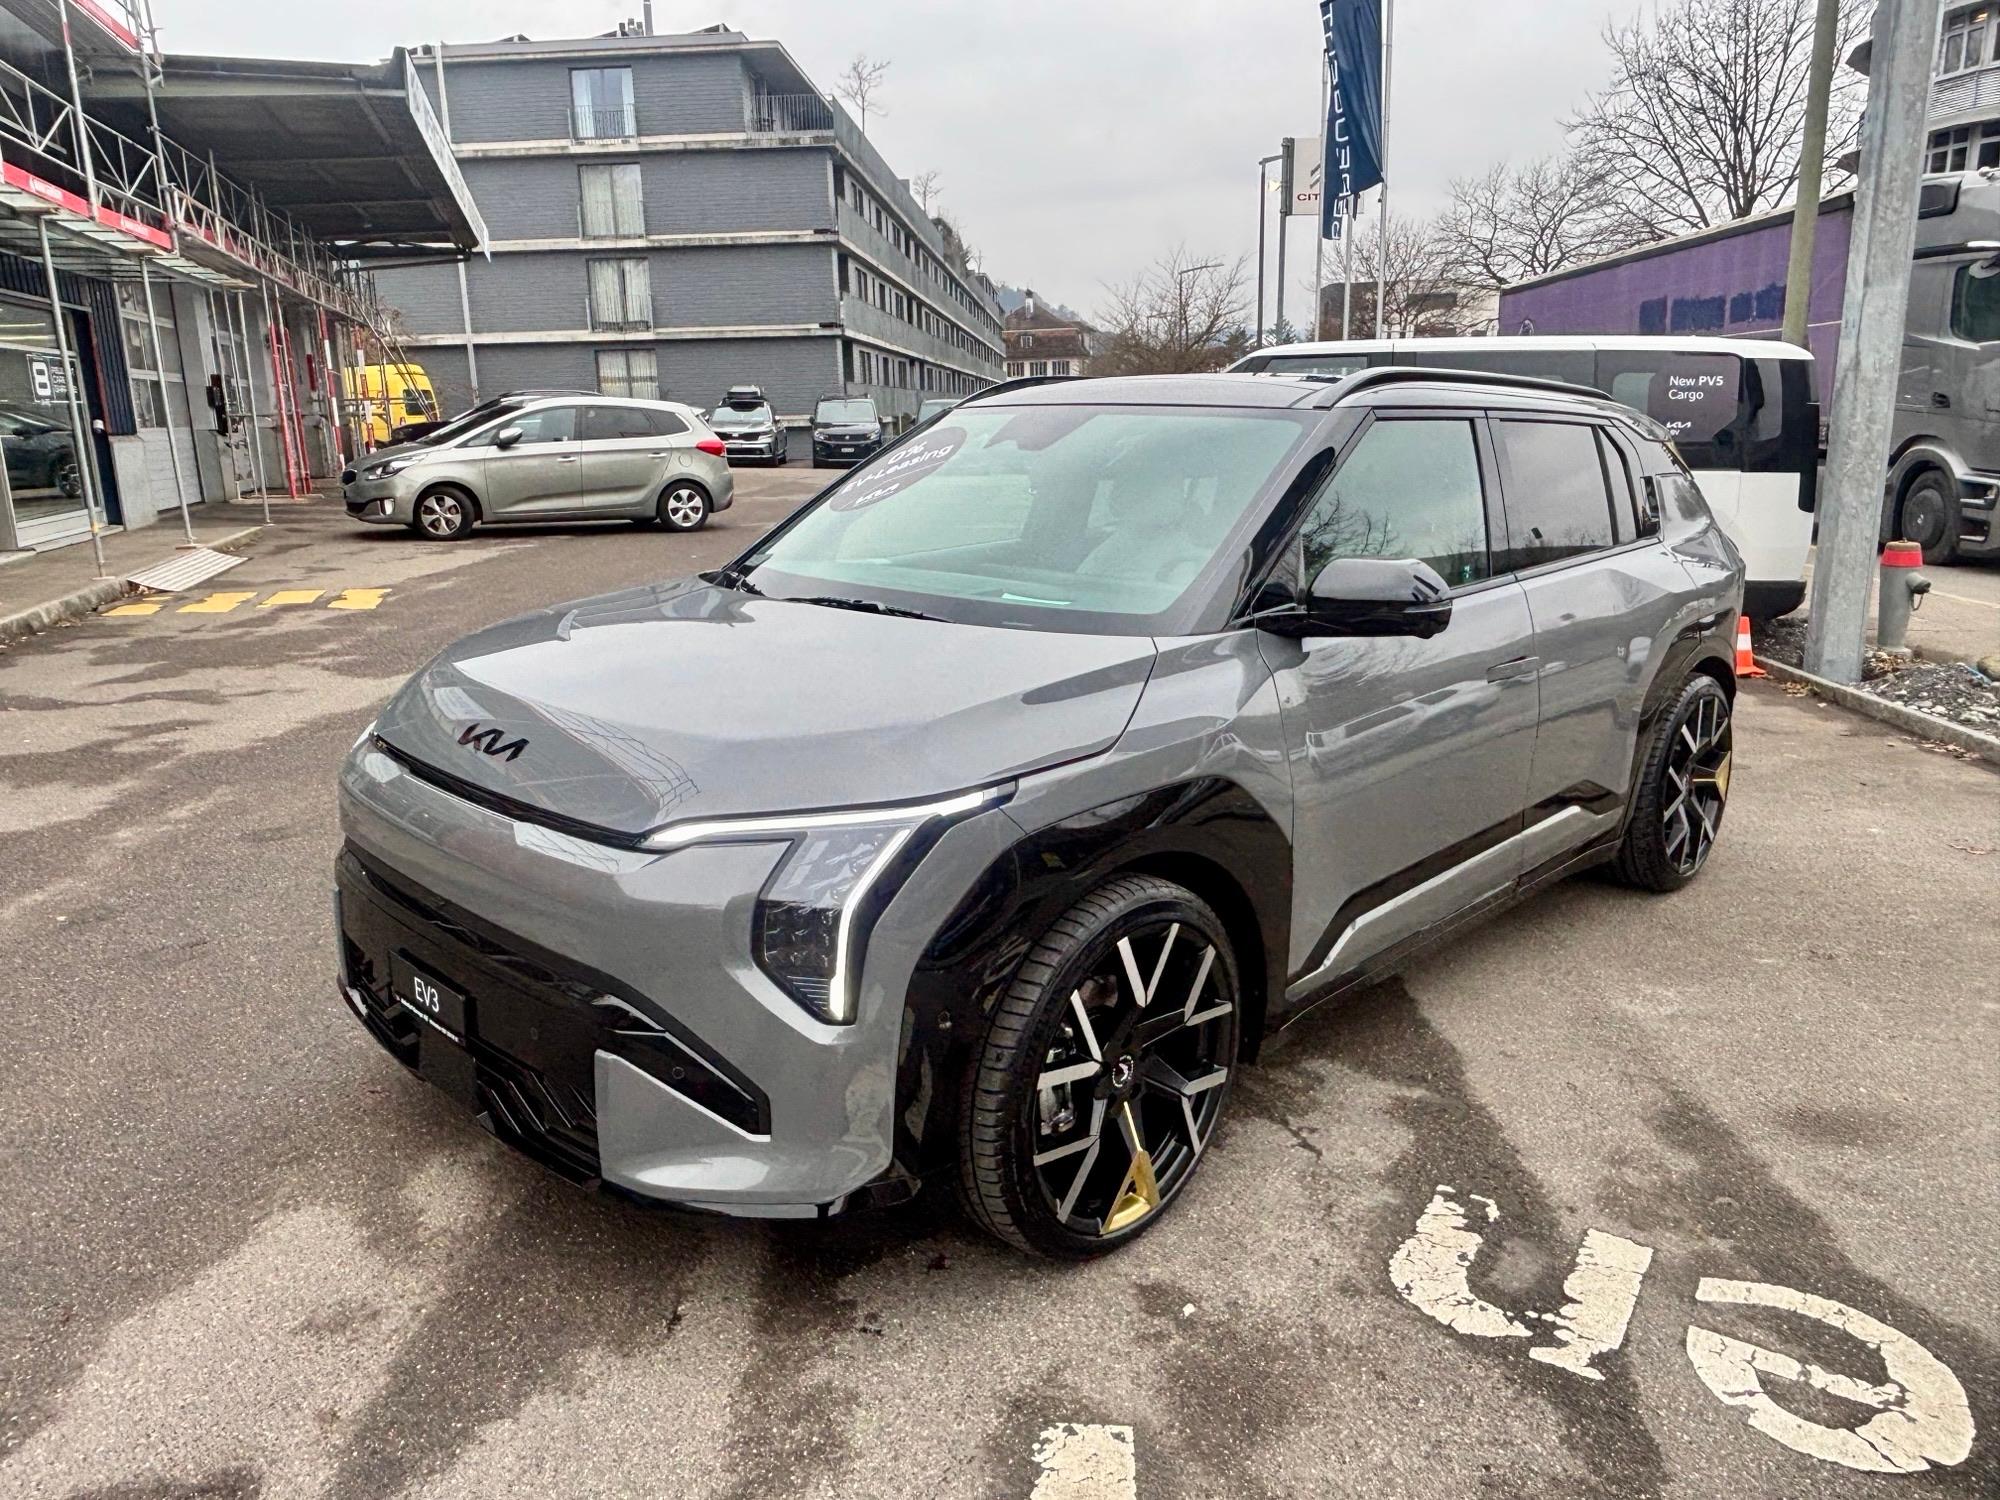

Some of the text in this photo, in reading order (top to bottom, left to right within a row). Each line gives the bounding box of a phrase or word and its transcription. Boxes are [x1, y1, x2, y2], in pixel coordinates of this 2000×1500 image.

[1297, 193, 1321, 201] CIT
[1669, 375, 1724, 387] New PV5
[1668, 389, 1704, 402] Cargo
[457, 722, 530, 762] KIA
[414, 975, 440, 1013] EV3
